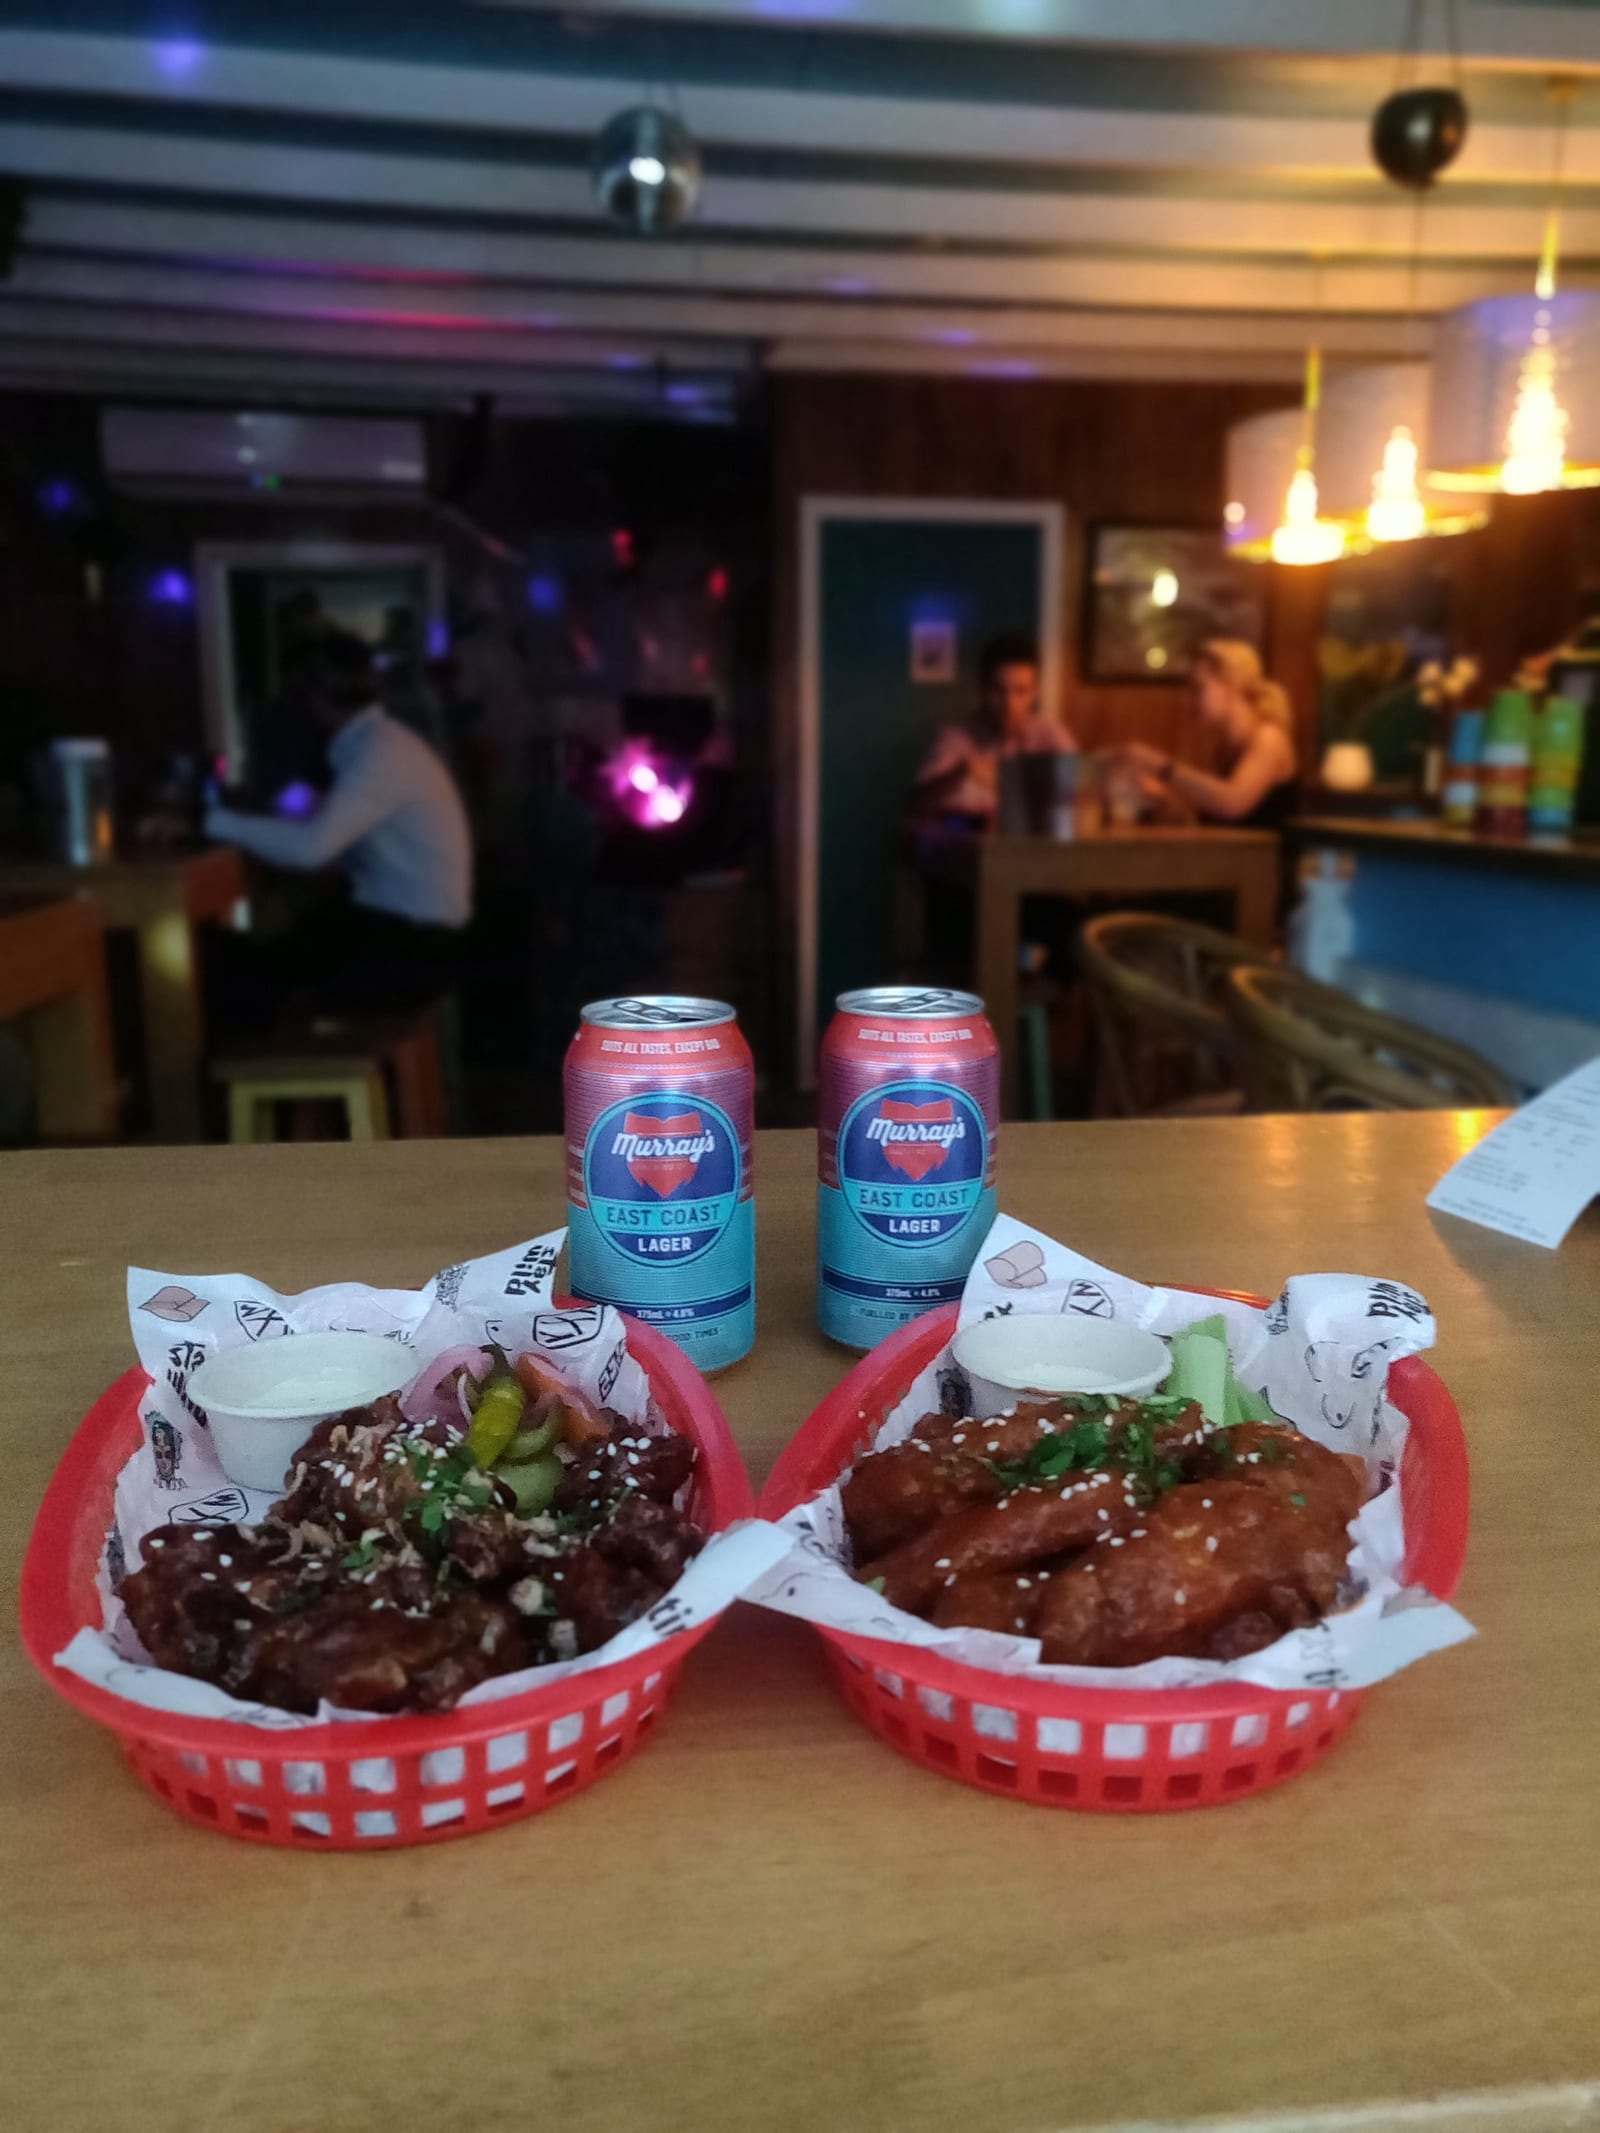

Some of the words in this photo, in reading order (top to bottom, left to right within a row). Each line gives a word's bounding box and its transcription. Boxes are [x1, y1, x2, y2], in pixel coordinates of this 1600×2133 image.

[866, 1116, 967, 1148] Murray's
[611, 1129, 717, 1162] Murray's
[860, 1188, 904, 1208] EAST
[911, 1187, 969, 1208] COAST
[607, 1206, 652, 1226] EAST
[660, 1203, 720, 1226] COAST
[889, 1219, 941, 1234] LAGER
[638, 1236, 692, 1252] LAGER
